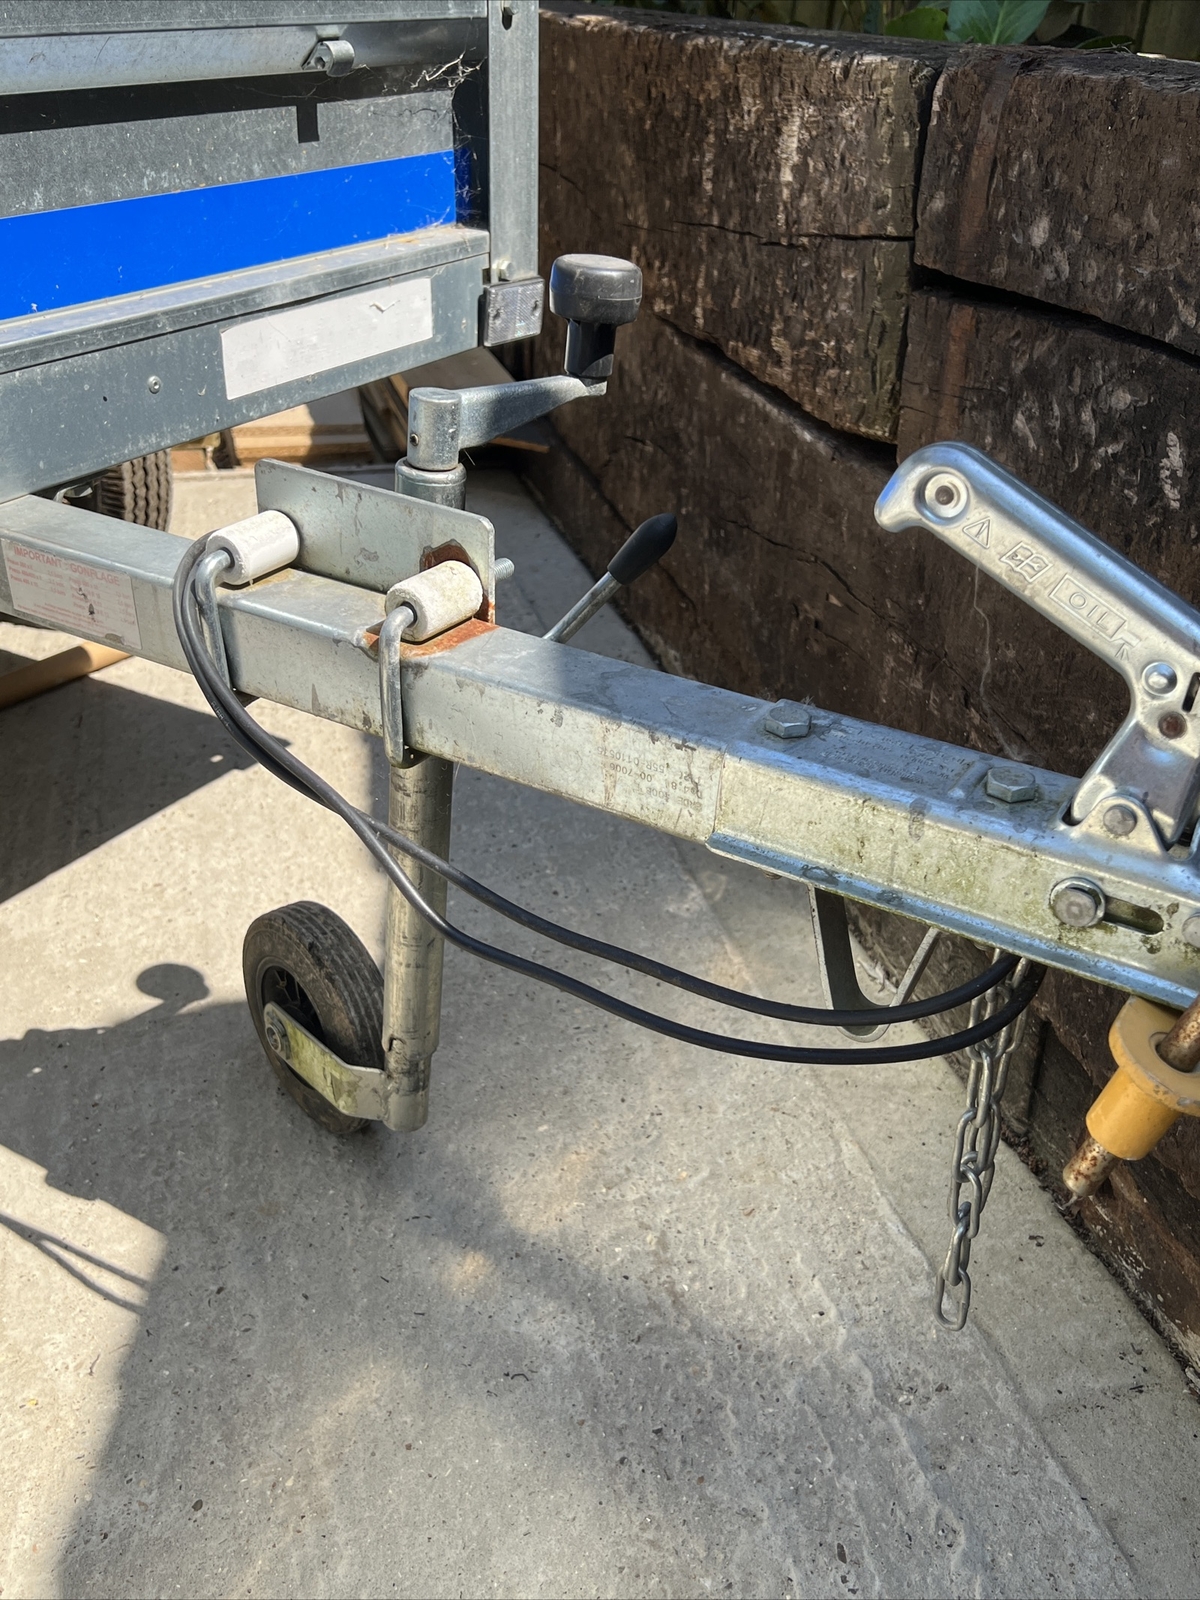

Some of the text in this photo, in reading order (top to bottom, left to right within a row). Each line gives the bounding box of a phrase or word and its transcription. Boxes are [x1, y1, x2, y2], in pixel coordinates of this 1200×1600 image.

[13, 545, 62, 567] IMPORTANT
[70, 562, 120, 586] GONFLAGE
[1068, 591, 1110, 632] OIL
